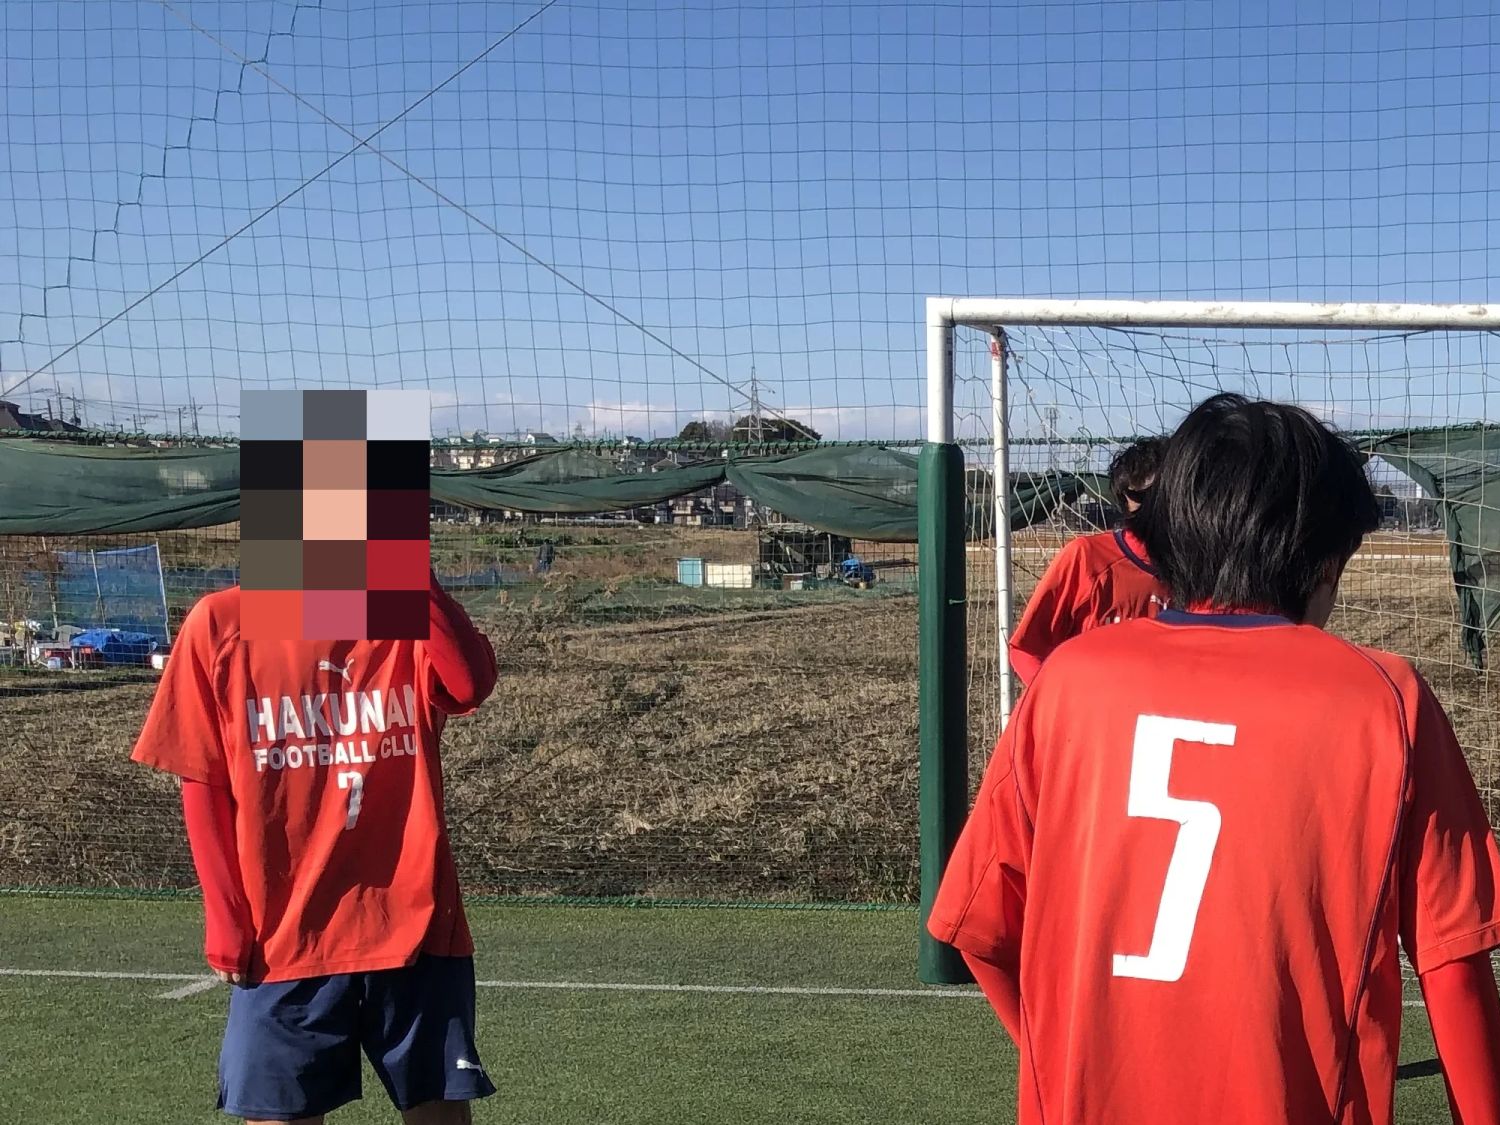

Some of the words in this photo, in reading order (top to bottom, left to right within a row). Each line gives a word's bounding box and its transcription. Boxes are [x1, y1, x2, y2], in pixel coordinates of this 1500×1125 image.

[253, 740, 377, 772] FOOTBALL
[380, 733, 417, 759] CLU
[337, 770, 364, 830] 7
[1112, 713, 1237, 982] 5
